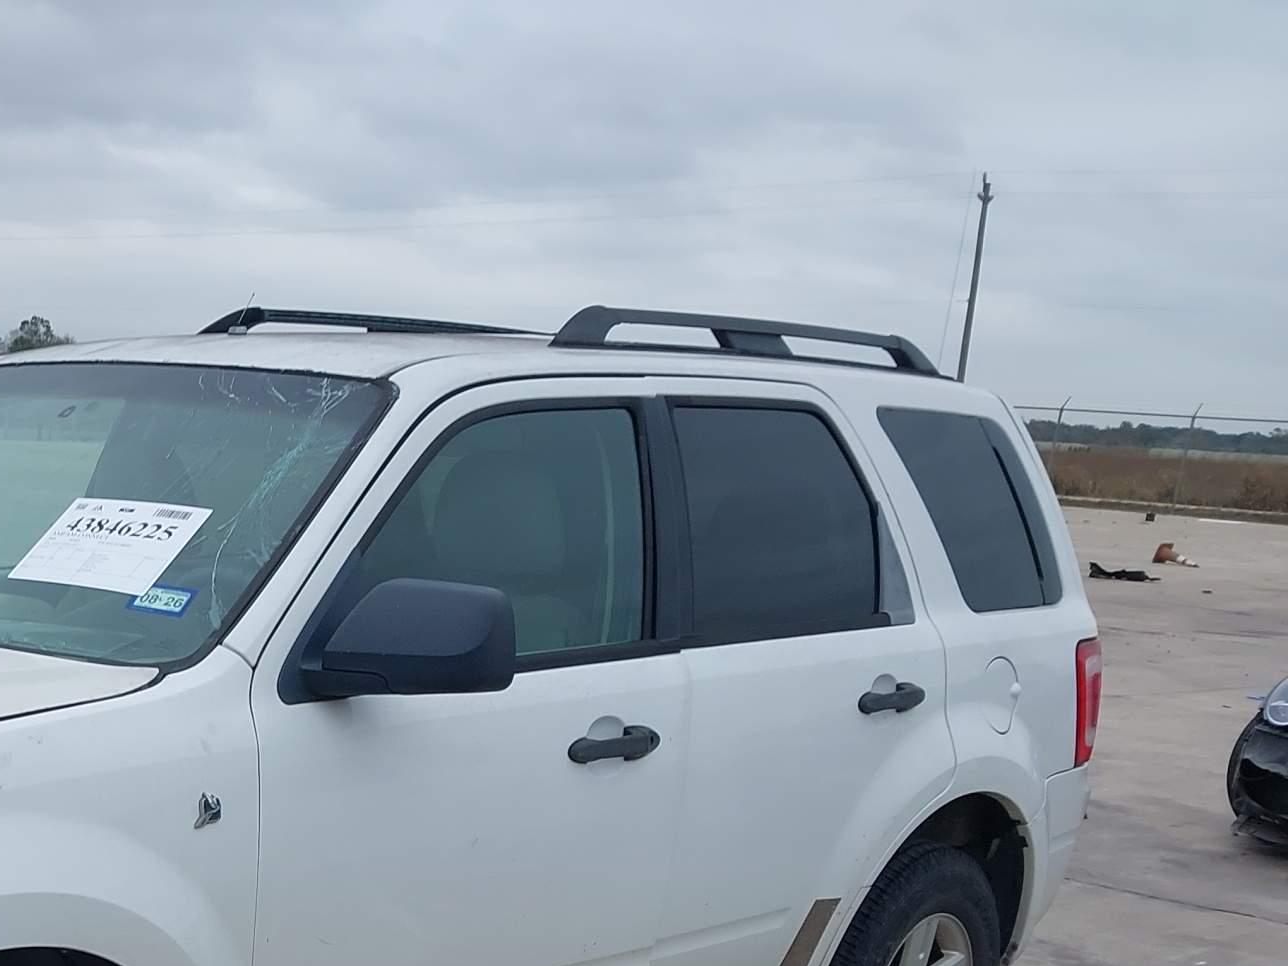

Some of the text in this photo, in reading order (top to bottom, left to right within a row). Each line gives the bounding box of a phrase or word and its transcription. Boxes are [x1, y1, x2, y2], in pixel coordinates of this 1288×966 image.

[66, 516, 179, 541] 43846225
[139, 593, 160, 604] 08
[163, 596, 185, 608] 26
